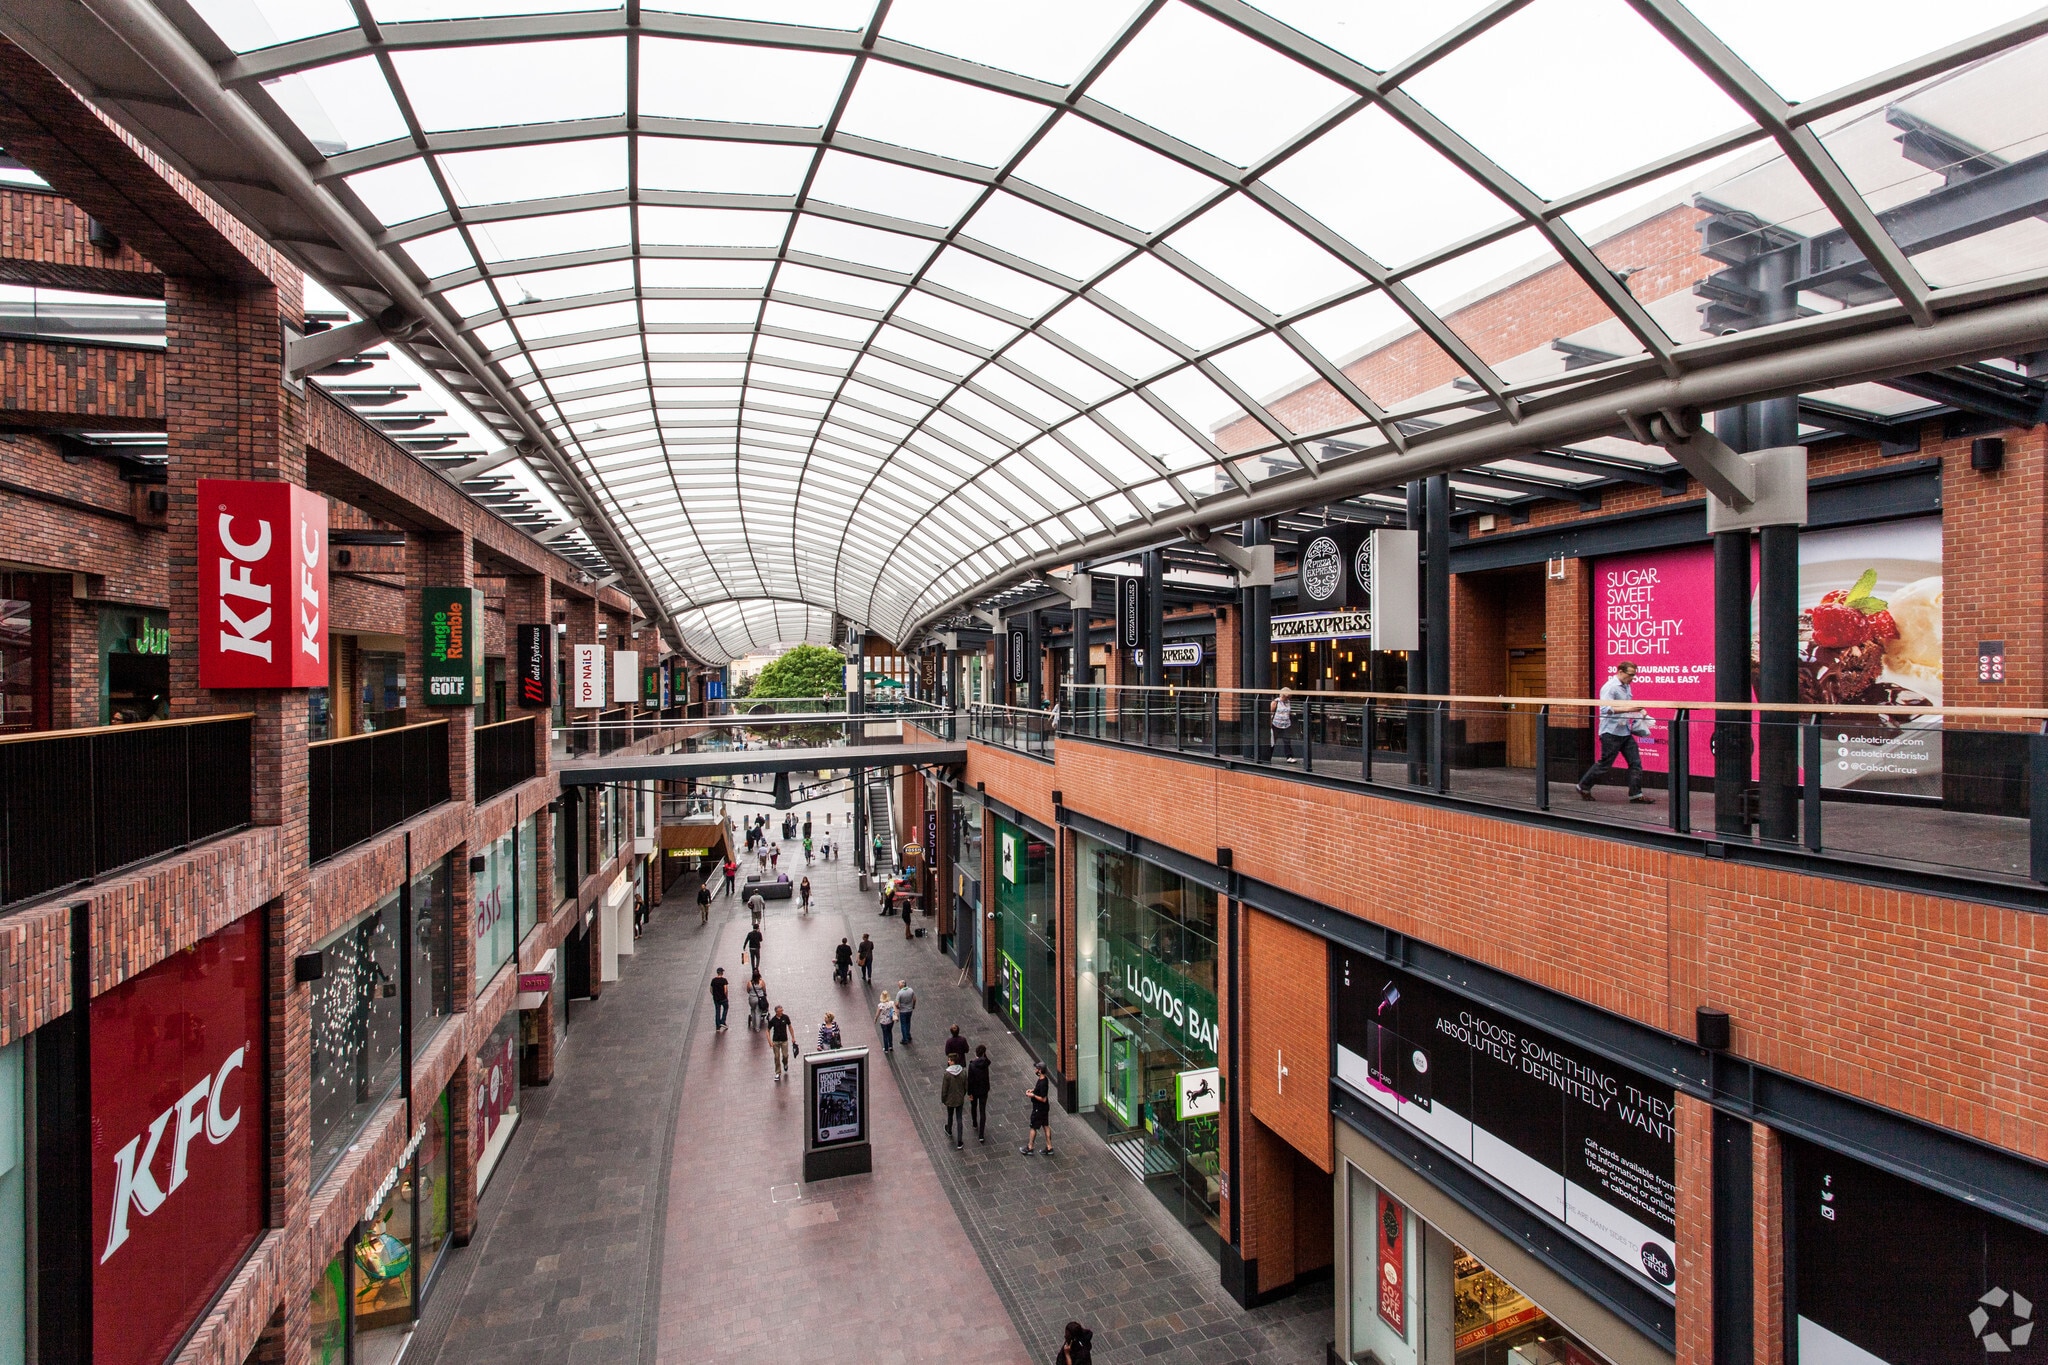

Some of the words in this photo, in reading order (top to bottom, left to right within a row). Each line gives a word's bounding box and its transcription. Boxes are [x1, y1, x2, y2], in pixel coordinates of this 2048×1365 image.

[1307, 565, 1337, 577] EXPRESS
[1312, 558, 1332, 569] PIZZA
[1607, 568, 1660, 588] SUGAR.
[218, 513, 272, 664] KFC
[301, 520, 320, 665] KFC
[1607, 585, 1654, 605] SWEET.
[1607, 604, 1653, 621] FRESH.
[447, 602, 463, 659] Rumble
[1271, 614, 1371, 637] PIZZAEXPRESS
[1607, 619, 1684, 638] NAUGHTY.
[431, 611, 450, 662] Jungle
[531, 627, 542, 662] Eyebrows
[1607, 638, 1670, 655] DELIGHT.
[923, 660, 932, 685] dwell
[1608, 666, 1618, 674] 30
[1682, 665, 1689, 673] &
[431, 682, 464, 695] GOLF
[1677, 676, 1700, 684] EASY.
[583, 684, 592, 702] TOP
[1850, 735, 1924, 746] cabotcircus.com
[1850, 749, 1929, 761] cabotcircusbristol
[1850, 762, 1918, 775] @CabotCircus
[928, 814, 936, 865] FOSSIL
[673, 848, 703, 857] scribbler
[1127, 964, 1183, 1027] LLOYDS
[820, 1070, 846, 1081] HOOTON
[1460, 1011, 1516, 1048] CHOOSE
[1521, 1038, 1617, 1096] SOMETHING
[1625, 1085, 1675, 1121] THEY
[820, 1077, 842, 1087] TENNIS
[1436, 1018, 1518, 1069] ABSOLUTELY,
[1522, 1056, 1611, 1111] DEFINITELY
[1617, 1102, 1676, 1143] WANT
[100, 1046, 245, 1265] KFC
[1585, 1138, 1598, 1150] Gift
[1599, 1146, 1620, 1162] cards
[1620, 1158, 1655, 1181] available
[1655, 1175, 1676, 1193] from
[1584, 1148, 1597, 1159] the
[1598, 1154, 1642, 1185] Information
[1643, 1179, 1663, 1197] Desk
[1664, 1194, 1676, 1204] on
[1586, 1158, 1608, 1176] Upper
[1609, 1172, 1639, 1194] Ground
[1640, 1190, 1649, 1199] or
[1650, 1196, 1676, 1215] online
[1601, 1179, 1610, 1188] at
[1610, 1184, 1676, 1226] cabotcircus.com
[1642, 1250, 1668, 1271] cabot
[1642, 1257, 1668, 1278] circus
[1382, 1280, 1400, 1305] 50%
[1382, 1292, 1400, 1312] OFF
[1381, 1301, 1401, 1325] SALE
[1506, 1316, 1520, 1326] SALE
[1462, 1336, 1474, 1344] OFF
[1473, 1328, 1488, 1339] SALE
